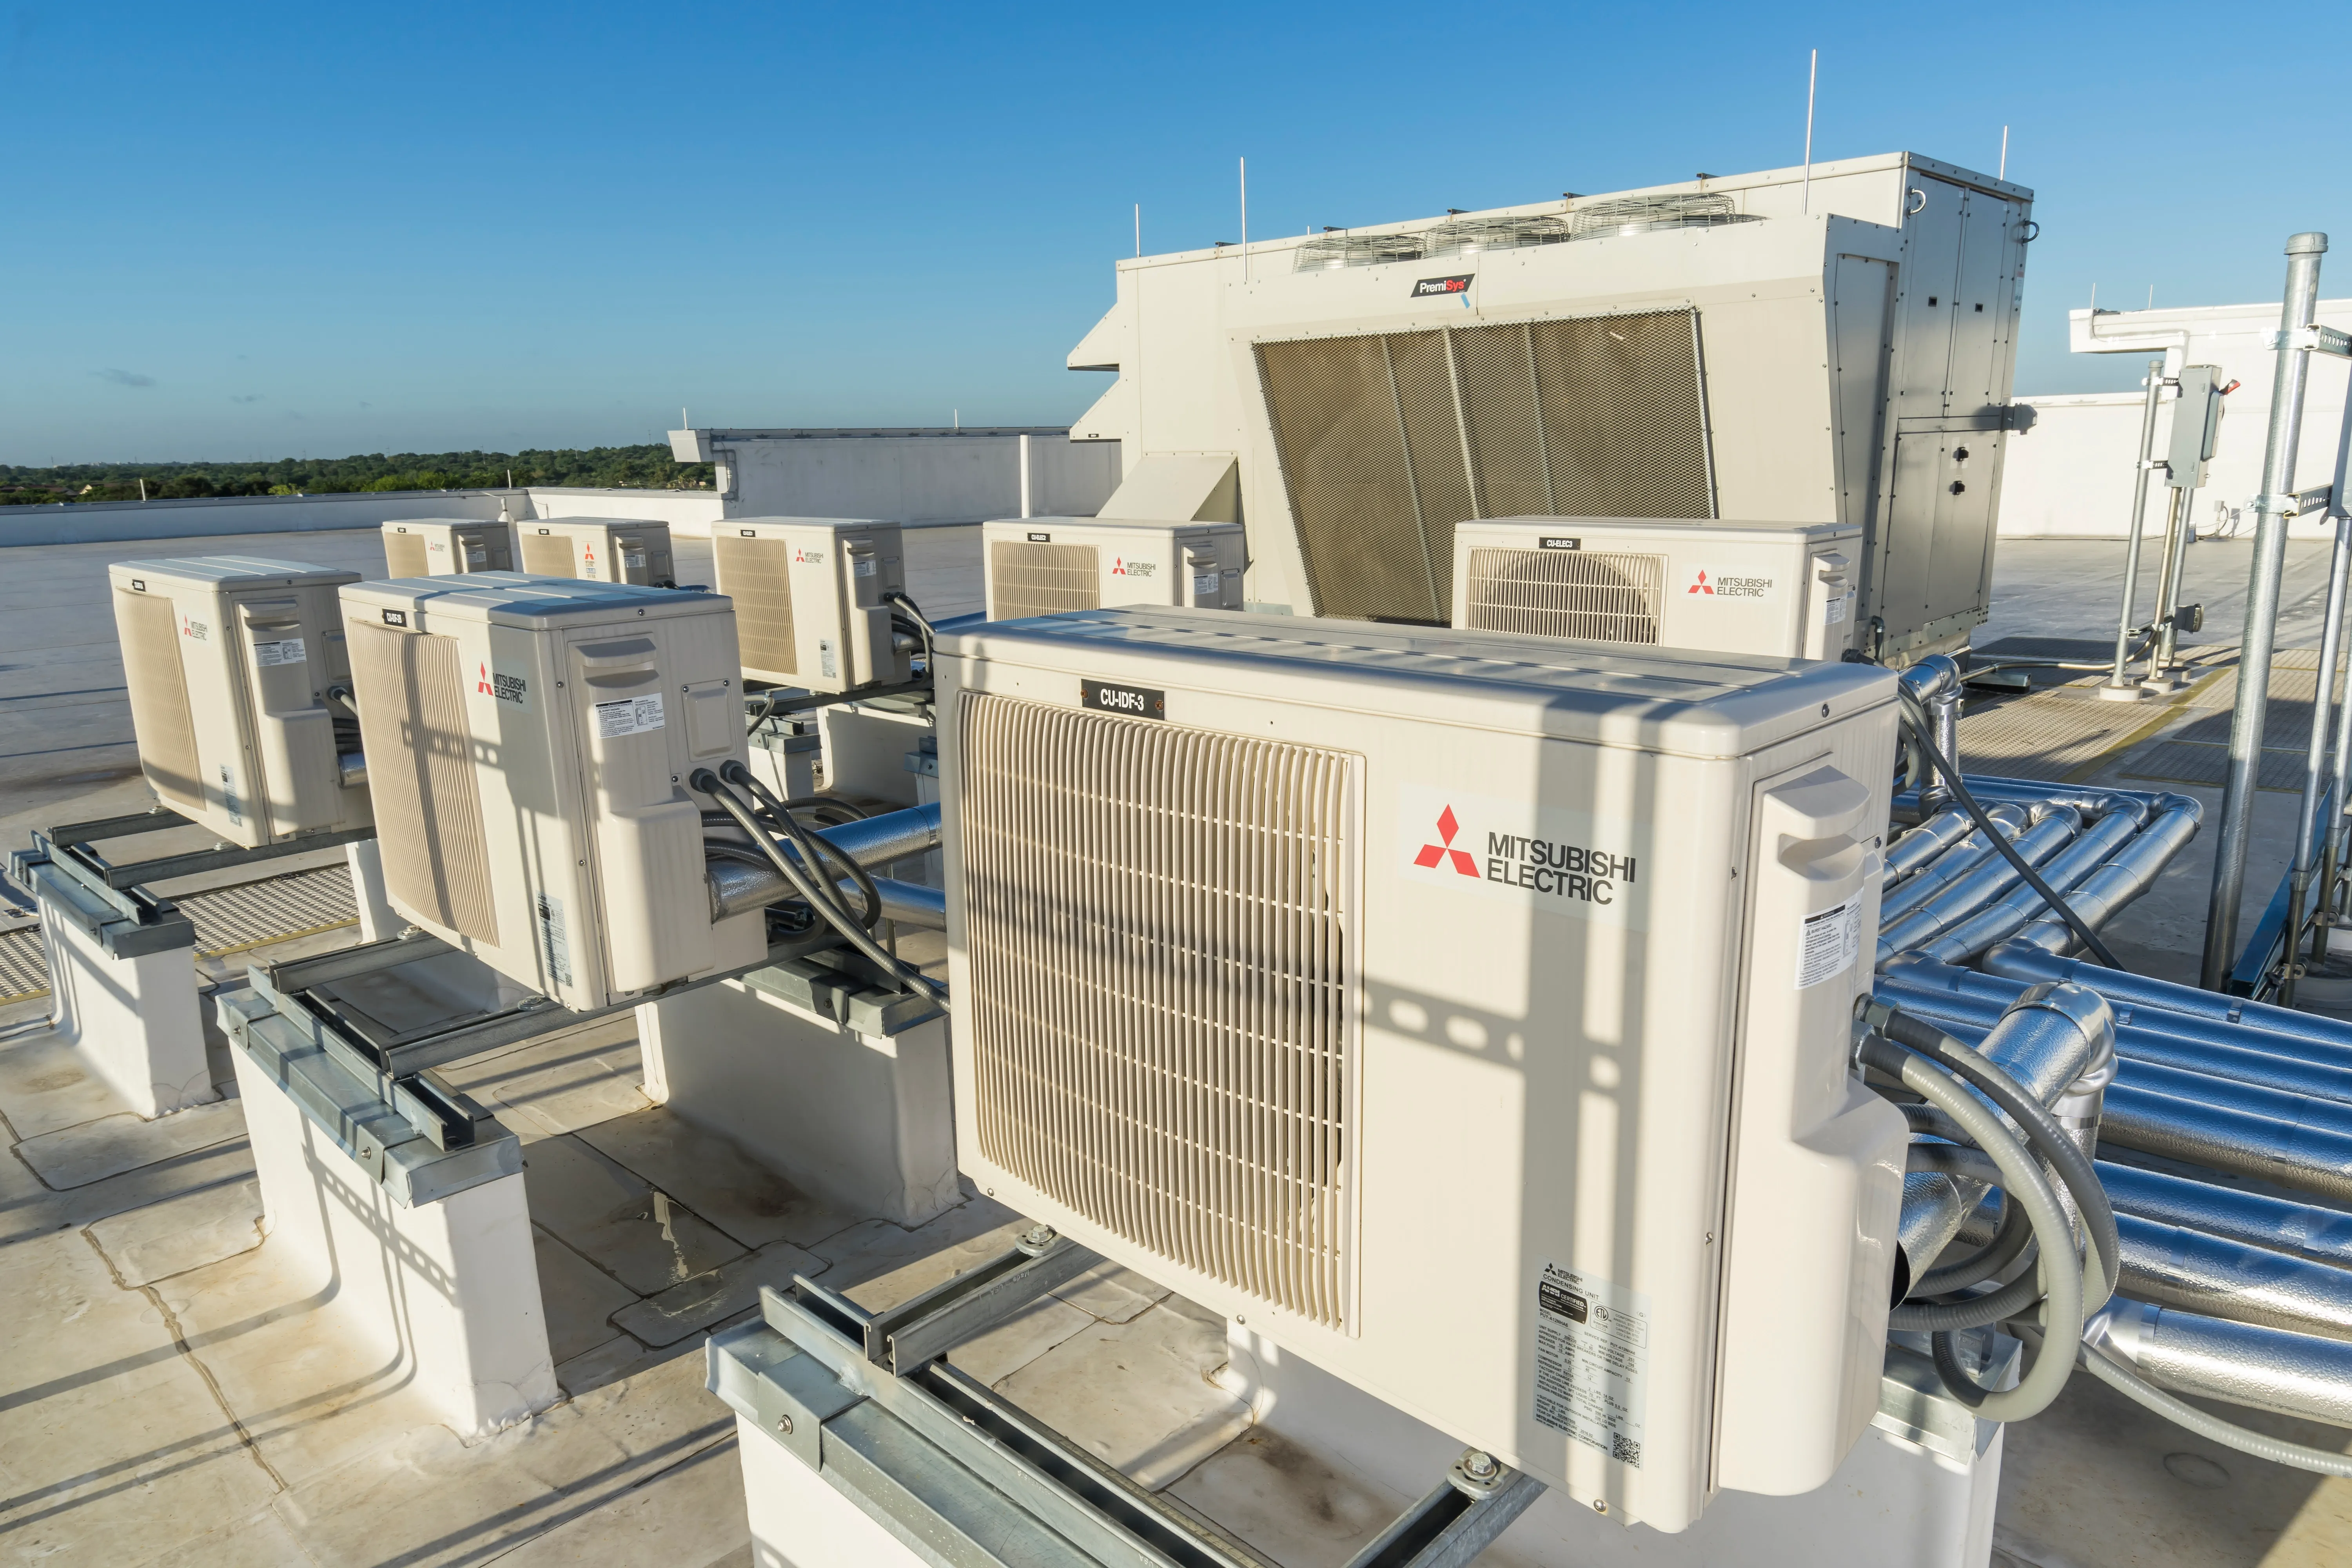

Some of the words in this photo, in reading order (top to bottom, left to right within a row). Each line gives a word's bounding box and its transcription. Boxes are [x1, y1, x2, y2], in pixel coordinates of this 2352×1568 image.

[1420, 280, 1464, 293] PremiSys
[1546, 539, 1573, 548] CU-ELEC3
[1718, 577, 1773, 588] MITSUBISHI
[1717, 587, 1764, 597] ELECTRIC
[493, 673, 526, 692] MITSUBISHI
[494, 685, 523, 704] ELECTRIC
[1100, 689, 1144, 711] CU-IDF-3
[1488, 831, 1636, 883] MITSUBISHI
[1487, 858, 1613, 905] ELECTRIC
[1557, 1273, 1579, 1285] ELECTRIC
[1558, 1269, 1583, 1282] MITSUBISHI
[1543, 1274, 1583, 1294] CONDENSING
[1585, 1290, 1599, 1300] UNIT
[1561, 1294, 1584, 1307] CERTIFIED
[1540, 1312, 1568, 1327] PUY-A12NHA6
[1593, 1320, 1608, 1328] Intertek
[1547, 1328, 1561, 1336] SUPPLY
[1584, 1331, 1600, 1341] SERVICE
[1538, 1334, 1555, 1345] BREAKER
[1539, 1330, 1558, 1340] APPROVED
[1576, 1345, 1596, 1357] BREAKERS
[1612, 1360, 1624, 1369] DELAY
[1546, 1350, 1559, 1358] MOTOR
[1538, 1354, 1562, 1368] COMPRESSOR
[1538, 1359, 1562, 1372] REFRIGERANT
[1539, 1365, 1555, 1374] FACTORY
[1555, 1372, 1573, 1383] CHARGED
[1604, 1368, 1622, 1378] AMPACITY
[1537, 1384, 1550, 1393] DESIGN
[1550, 1390, 1571, 1402] PRESSURES
[1546, 1379, 1567, 1390] ADDITIONAL
[1576, 1392, 1588, 1400] LIQUID
[1570, 1384, 1587, 1394] EXCEEDS
[1537, 1398, 1550, 1407] WEIGHT
[1539, 1380, 1557, 1390] INSTALLER
[1576, 1396, 1588, 1405] TOTAL
[1588, 1402, 1604, 1412] CHARGE
[1537, 1403, 1549, 1412] SERIAL
[1564, 1406, 1582, 1417] OUTDOOR
[1552, 1415, 1577, 1430] MANUFACTURE
[1536, 1413, 1558, 1427] MITSUBISHI
[1558, 1424, 1578, 1436] ELECTRIC
[1578, 1434, 1608, 1451] CORPORATION
